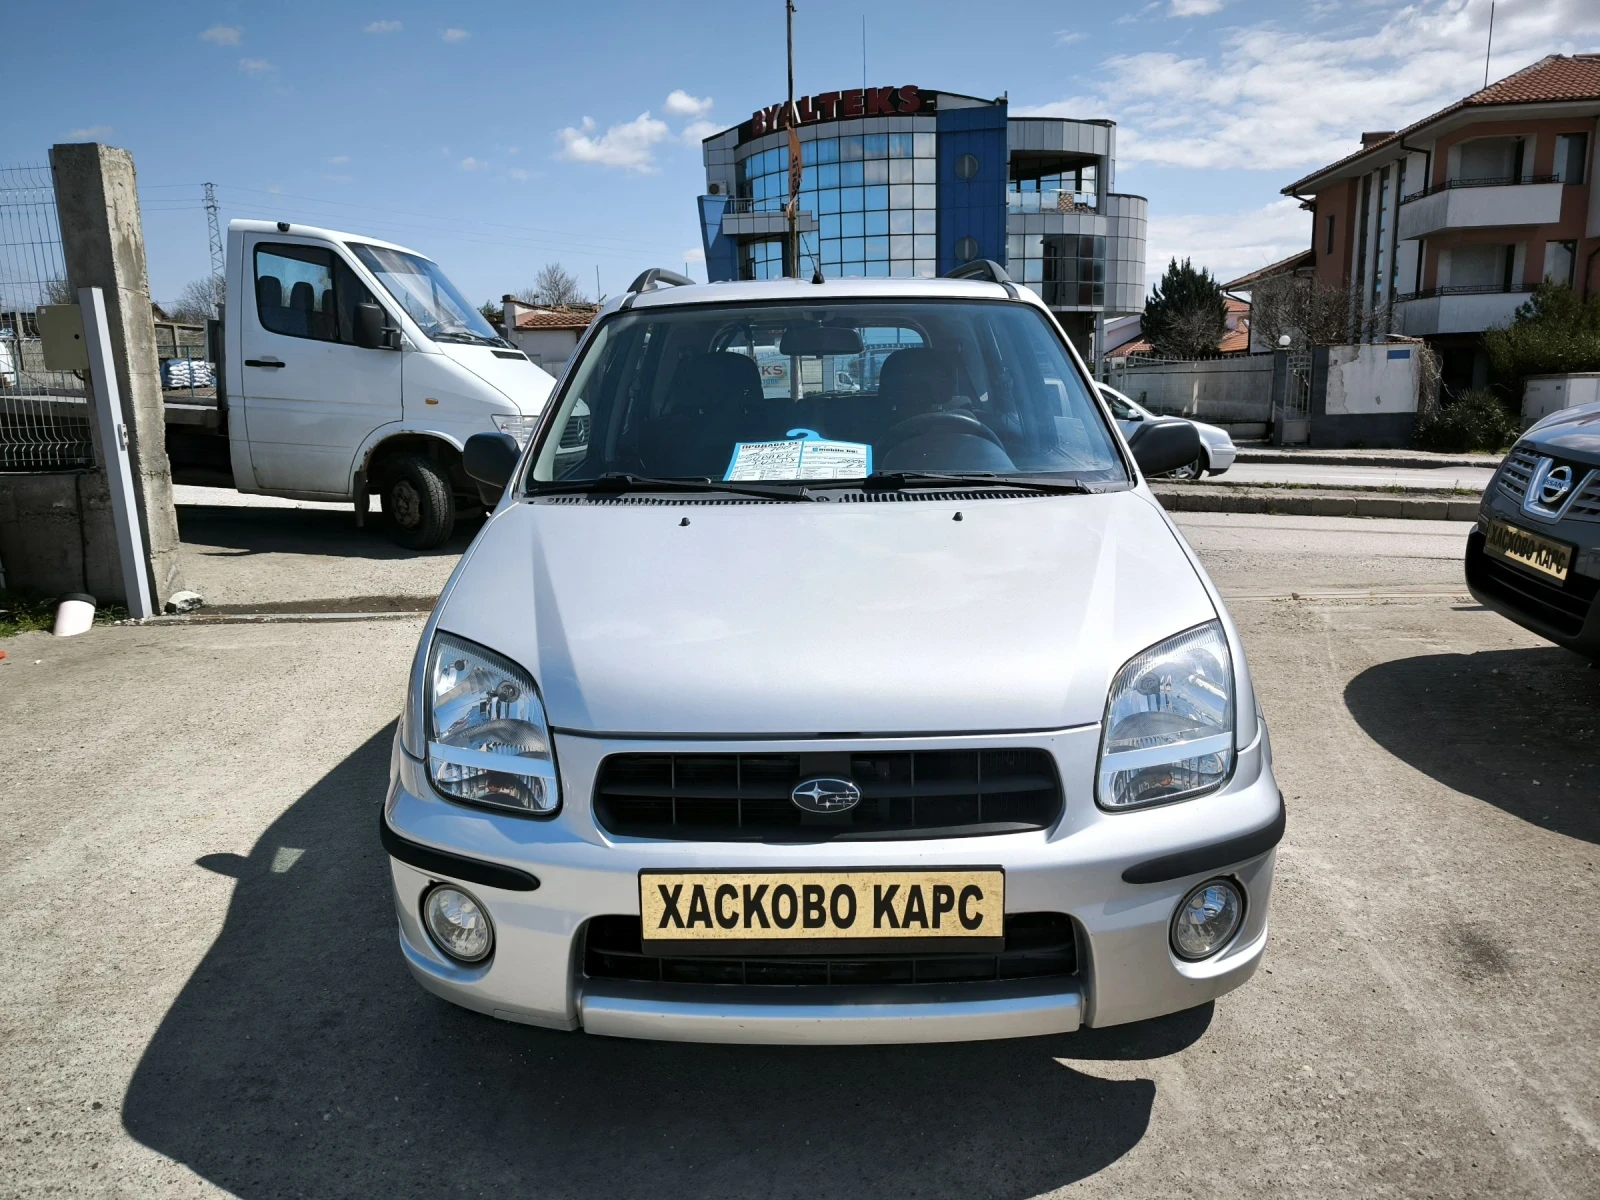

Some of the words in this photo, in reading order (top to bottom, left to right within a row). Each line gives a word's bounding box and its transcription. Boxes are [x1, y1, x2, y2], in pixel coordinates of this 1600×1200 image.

[752, 85, 921, 136] BYALTEKS
[1544, 480, 1564, 488] SSAN
[658, 884, 857, 929] ХАСКОВО
[873, 884, 984, 930] КАРС
